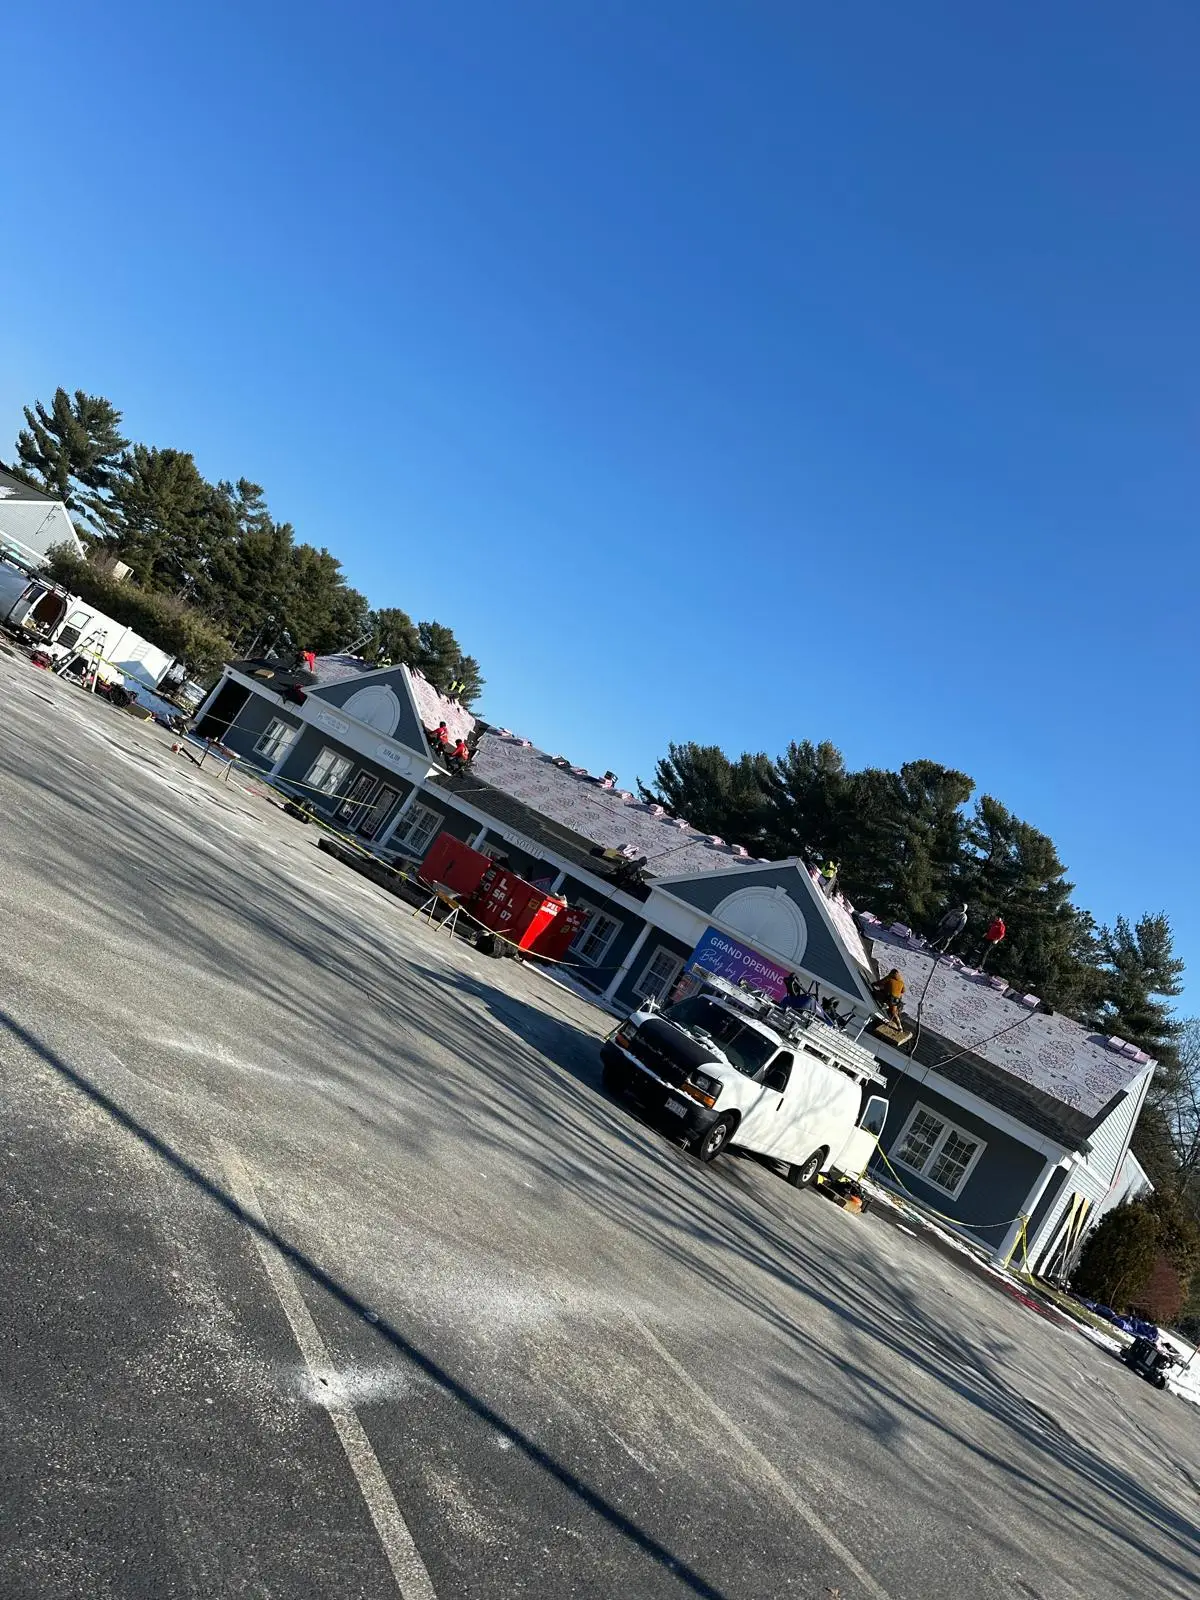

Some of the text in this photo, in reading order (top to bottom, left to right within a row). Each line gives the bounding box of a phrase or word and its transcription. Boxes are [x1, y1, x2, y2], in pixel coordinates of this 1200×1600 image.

[700, 948, 725, 974] Body
[724, 960, 737, 979] by
[710, 936, 785, 986] GRAND OPENING
